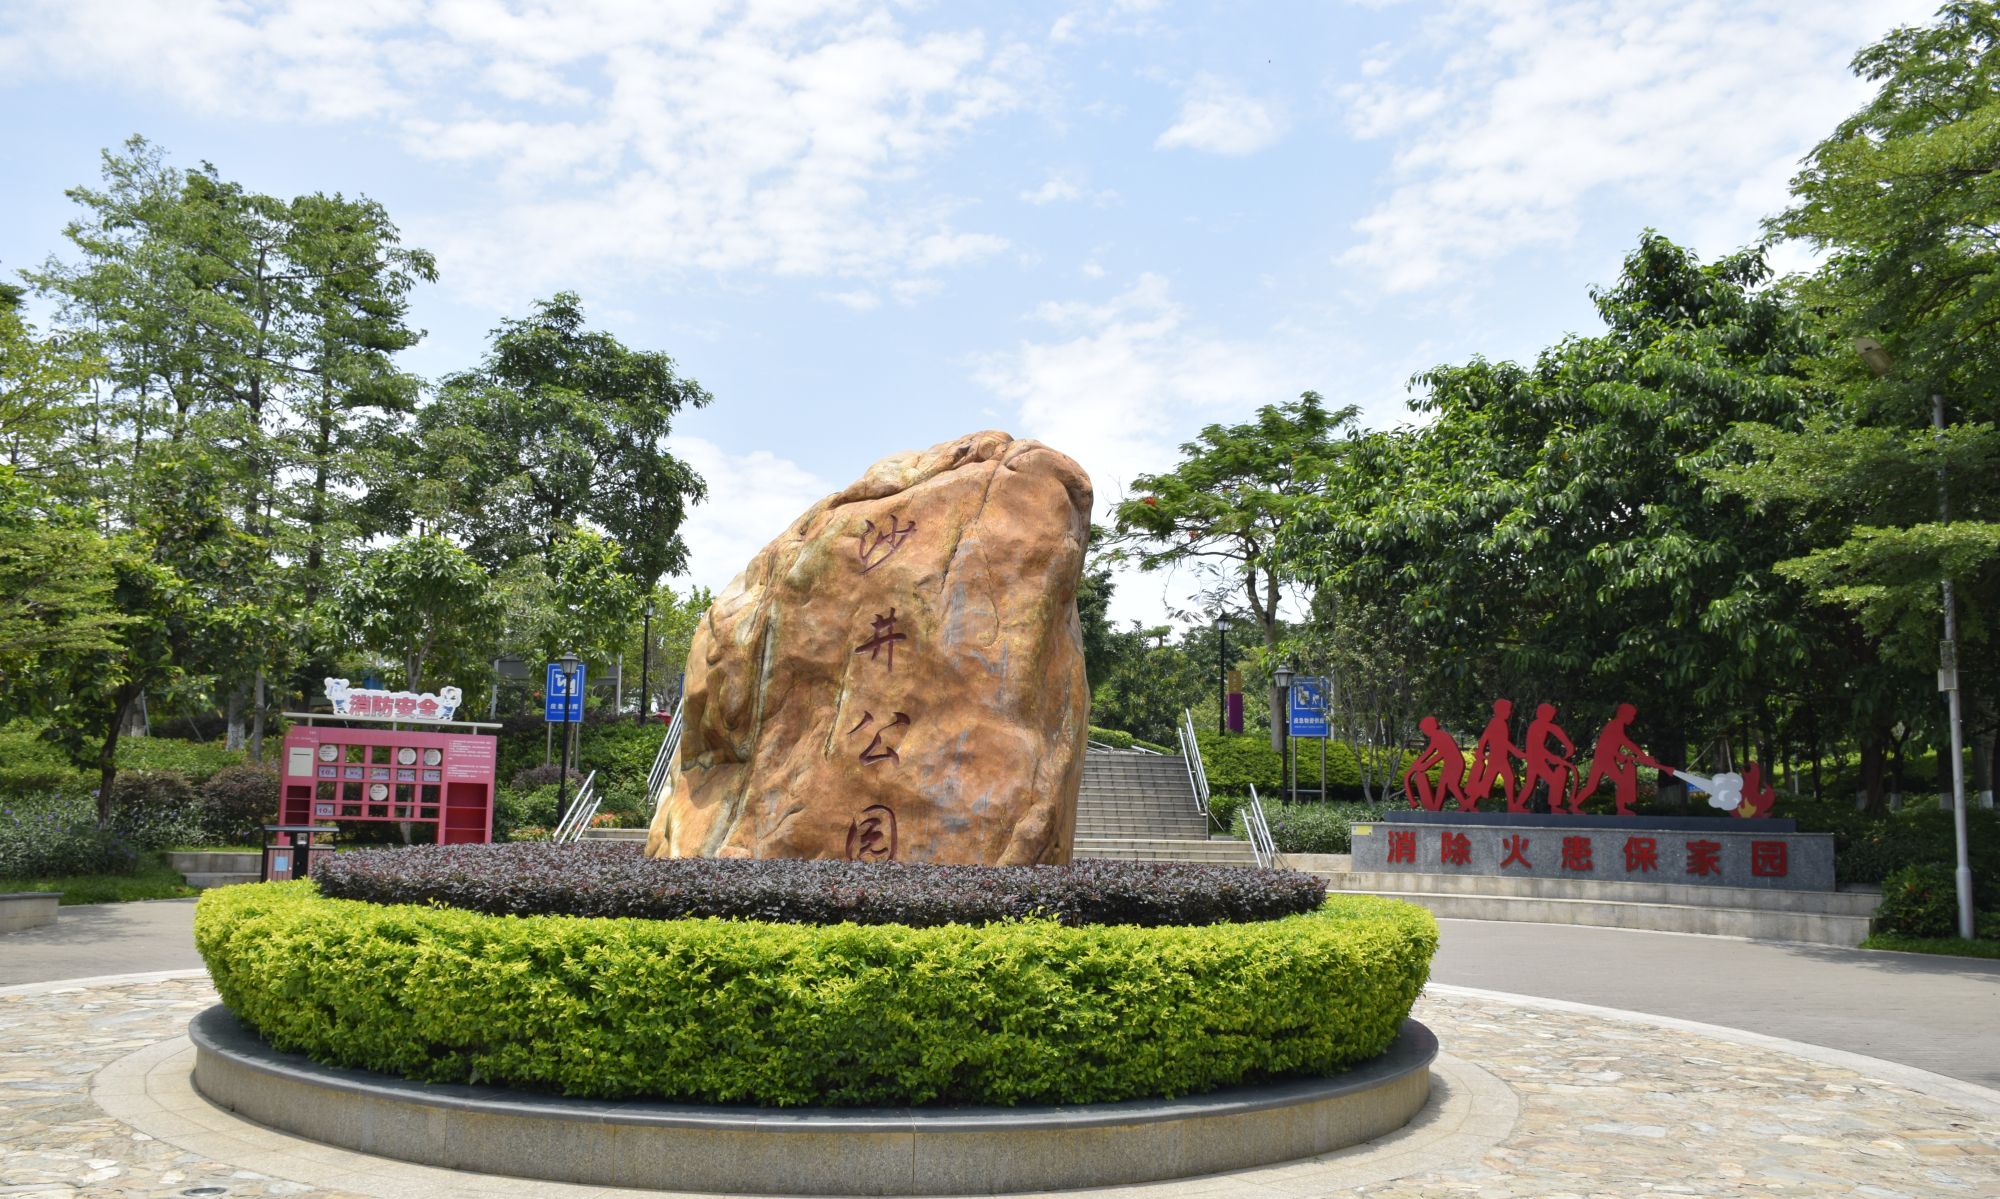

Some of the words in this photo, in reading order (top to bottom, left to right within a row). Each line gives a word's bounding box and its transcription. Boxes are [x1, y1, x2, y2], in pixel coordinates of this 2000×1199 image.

[349, 694, 438, 717] 消防安全
[846, 514, 916, 860] 沙井公园
[1387, 830, 1788, 878] 消除火患保家园
